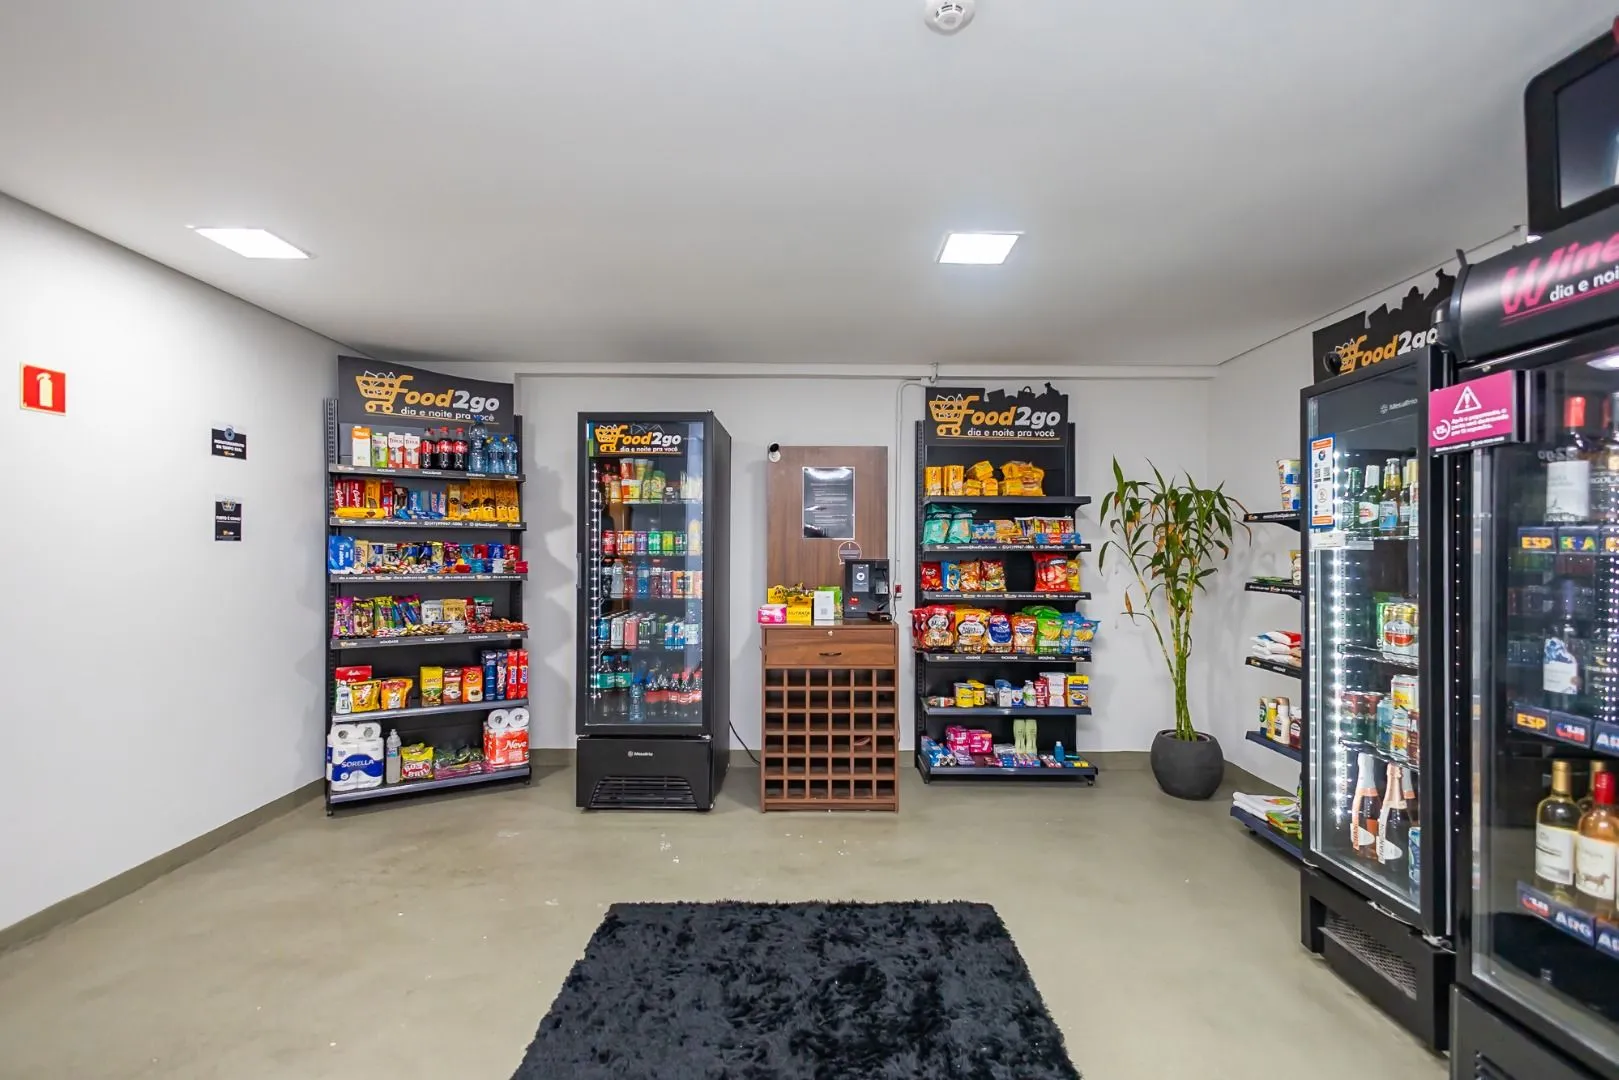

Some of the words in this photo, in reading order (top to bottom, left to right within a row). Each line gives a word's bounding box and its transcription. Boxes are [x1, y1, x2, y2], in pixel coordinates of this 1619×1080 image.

[1549, 284, 1574, 302] dia
[1578, 280, 1589, 292] e
[400, 407, 417, 416] dia
[429, 409, 453, 419] noite
[455, 412, 471, 421] pra
[967, 428, 981, 437] dia
[992, 428, 1015, 437] noite
[1017, 430, 1032, 438] pra
[1035, 428, 1055, 437] você
[341, 759, 374, 768] SORELLA
